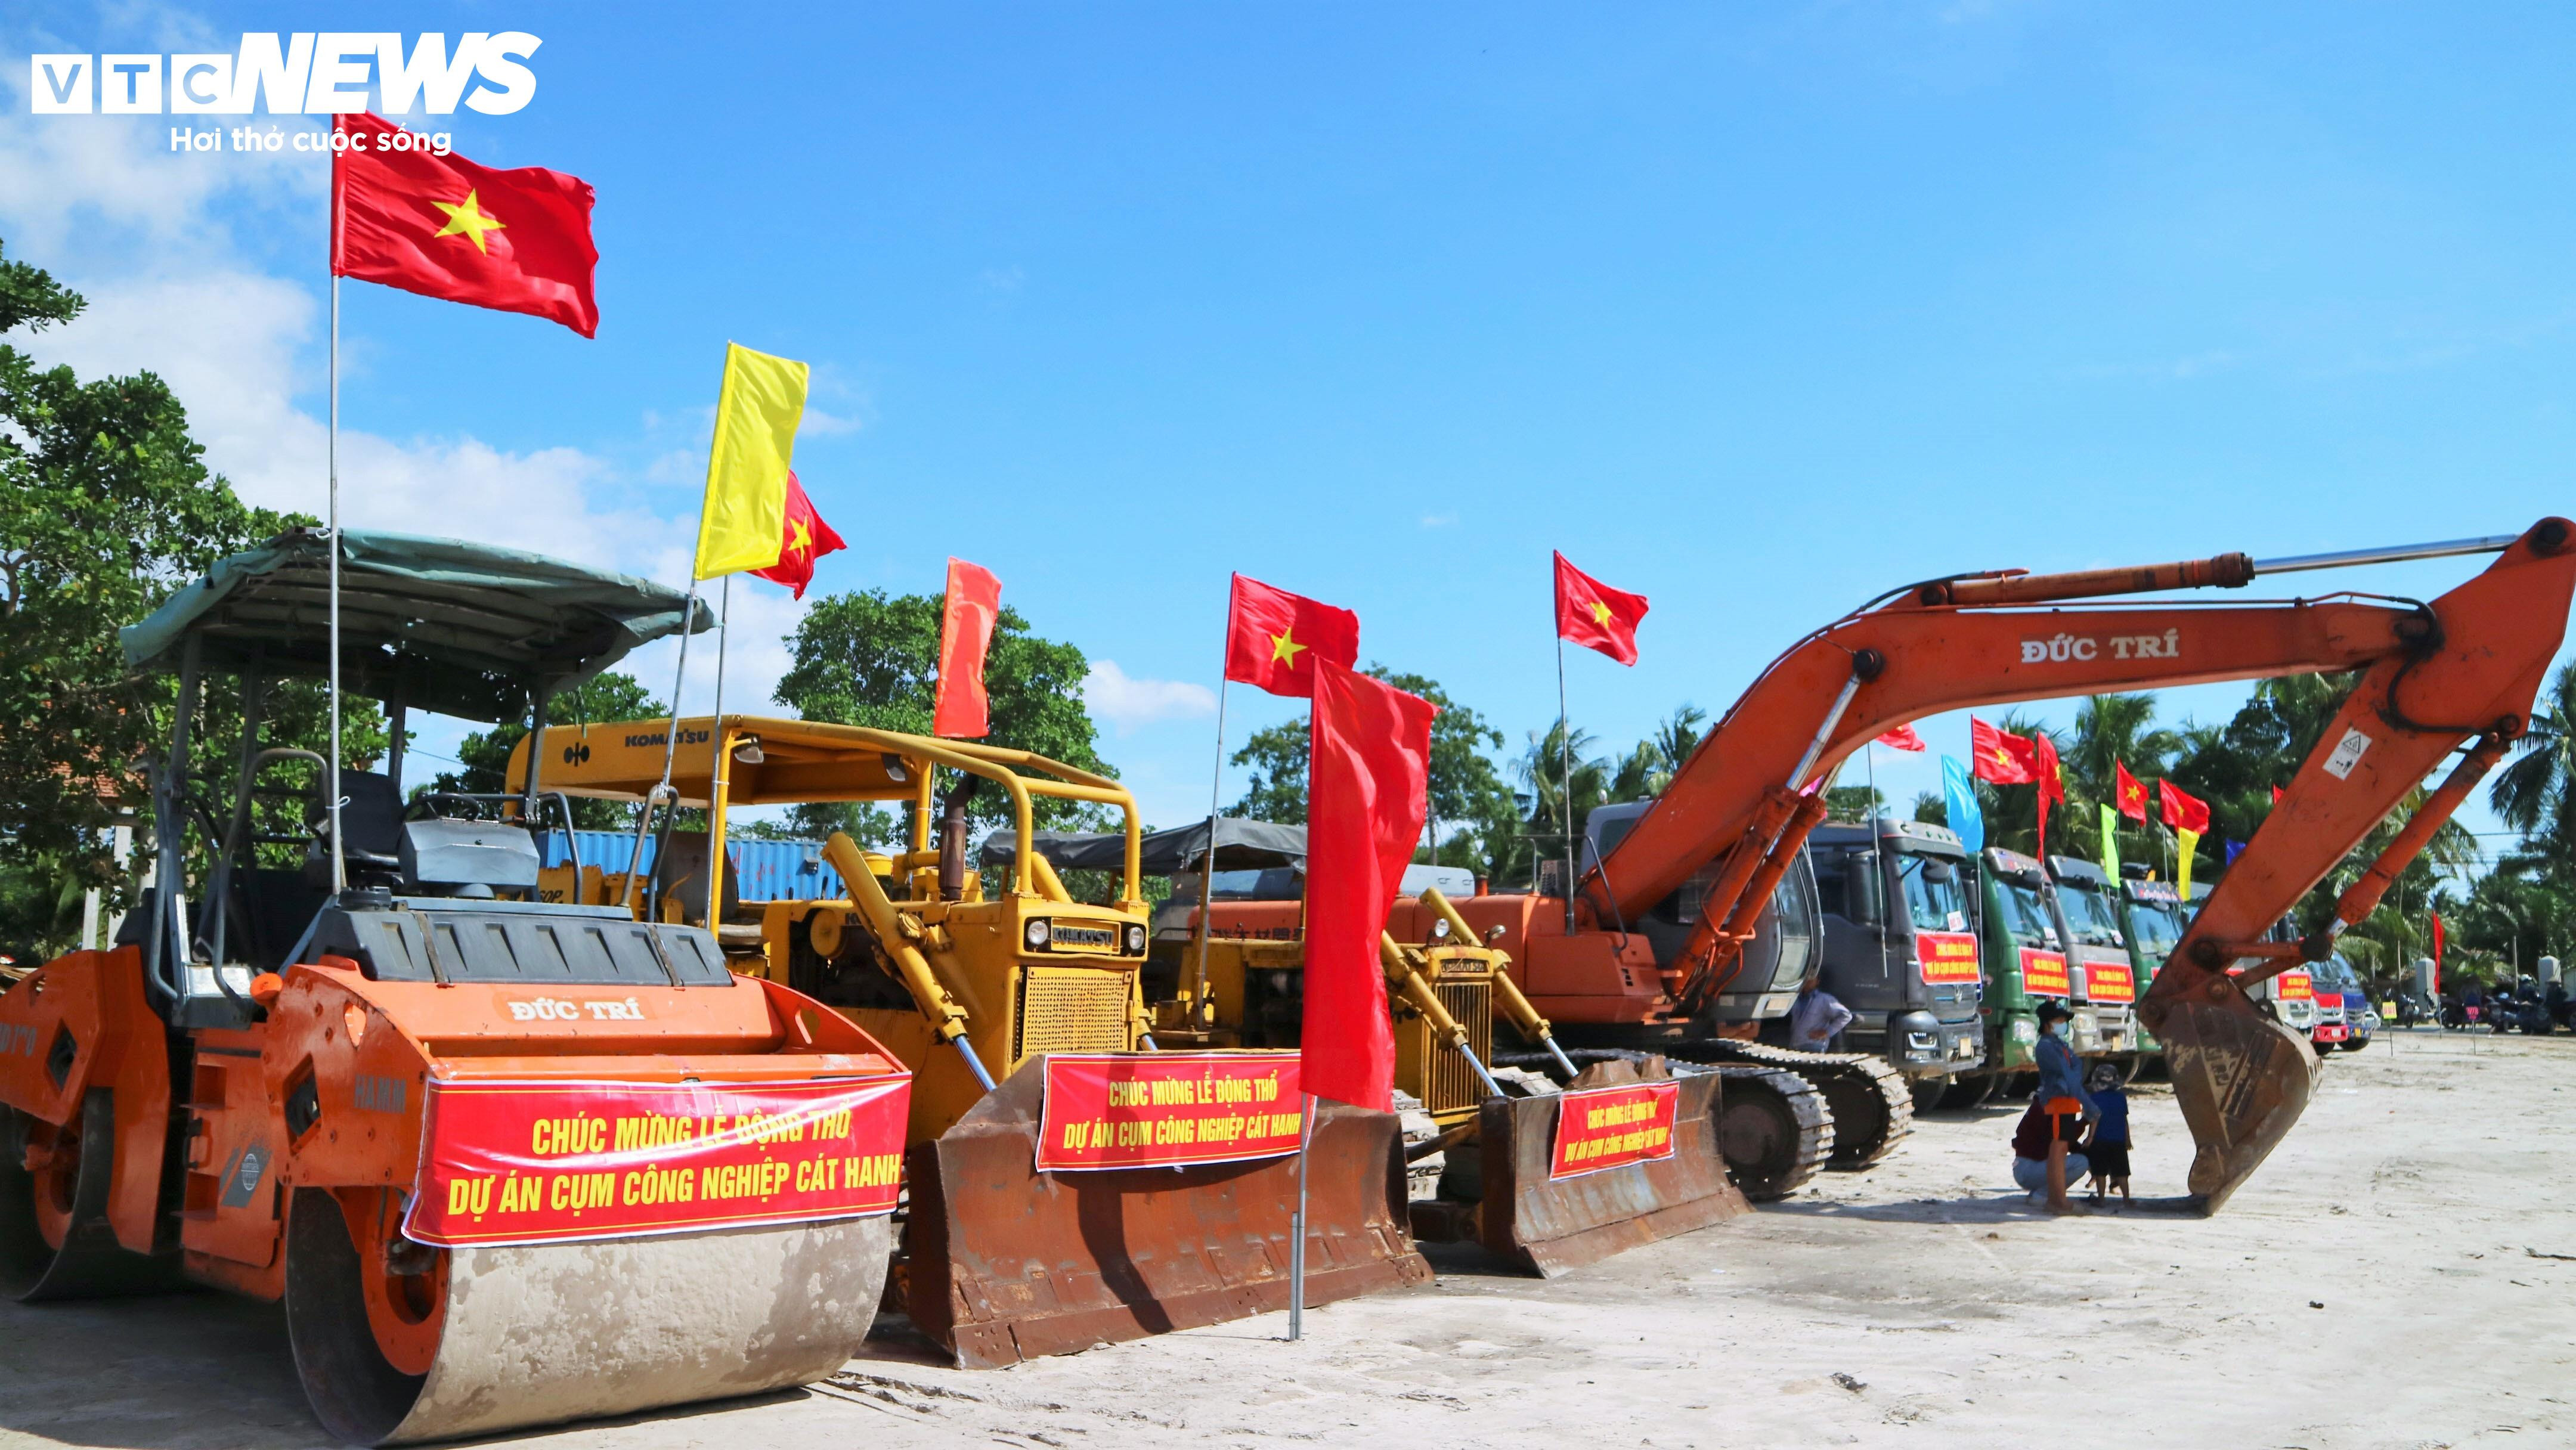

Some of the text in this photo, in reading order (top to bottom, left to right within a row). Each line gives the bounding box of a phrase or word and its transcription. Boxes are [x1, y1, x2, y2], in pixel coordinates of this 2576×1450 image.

[2021, 628, 2179, 663] ĐỨC TRÍ
[1052, 927, 1113, 946] KOMATSU
[507, 996, 645, 1021] ĐỨC TRÍ
[354, 1074, 406, 1114] HAMM
[1109, 1070, 1278, 1108] CHÚC MỪNG LỄ ĐỘNG THỔ
[532, 1111, 607, 1155] CHÚC
[614, 1110, 692, 1152] MỪNG
[699, 1104, 730, 1147] LỄ
[734, 1108, 803, 1151] ĐỘNG
[1063, 1111, 1301, 1154] DỰ ÁN CỤM CÔNG NGHIỆP CÁT HANH
[1587, 1105, 1605, 1130] CHÚC
[1575, 1138, 1589, 1160] ÁN
[1587, 1138, 1605, 1162] CỤM
[1603, 1133, 1623, 1155] CÔNG
[448, 1152, 900, 1222] DỰ ÁN CỤM CÔNG NGHIỆP CÁT HANH
